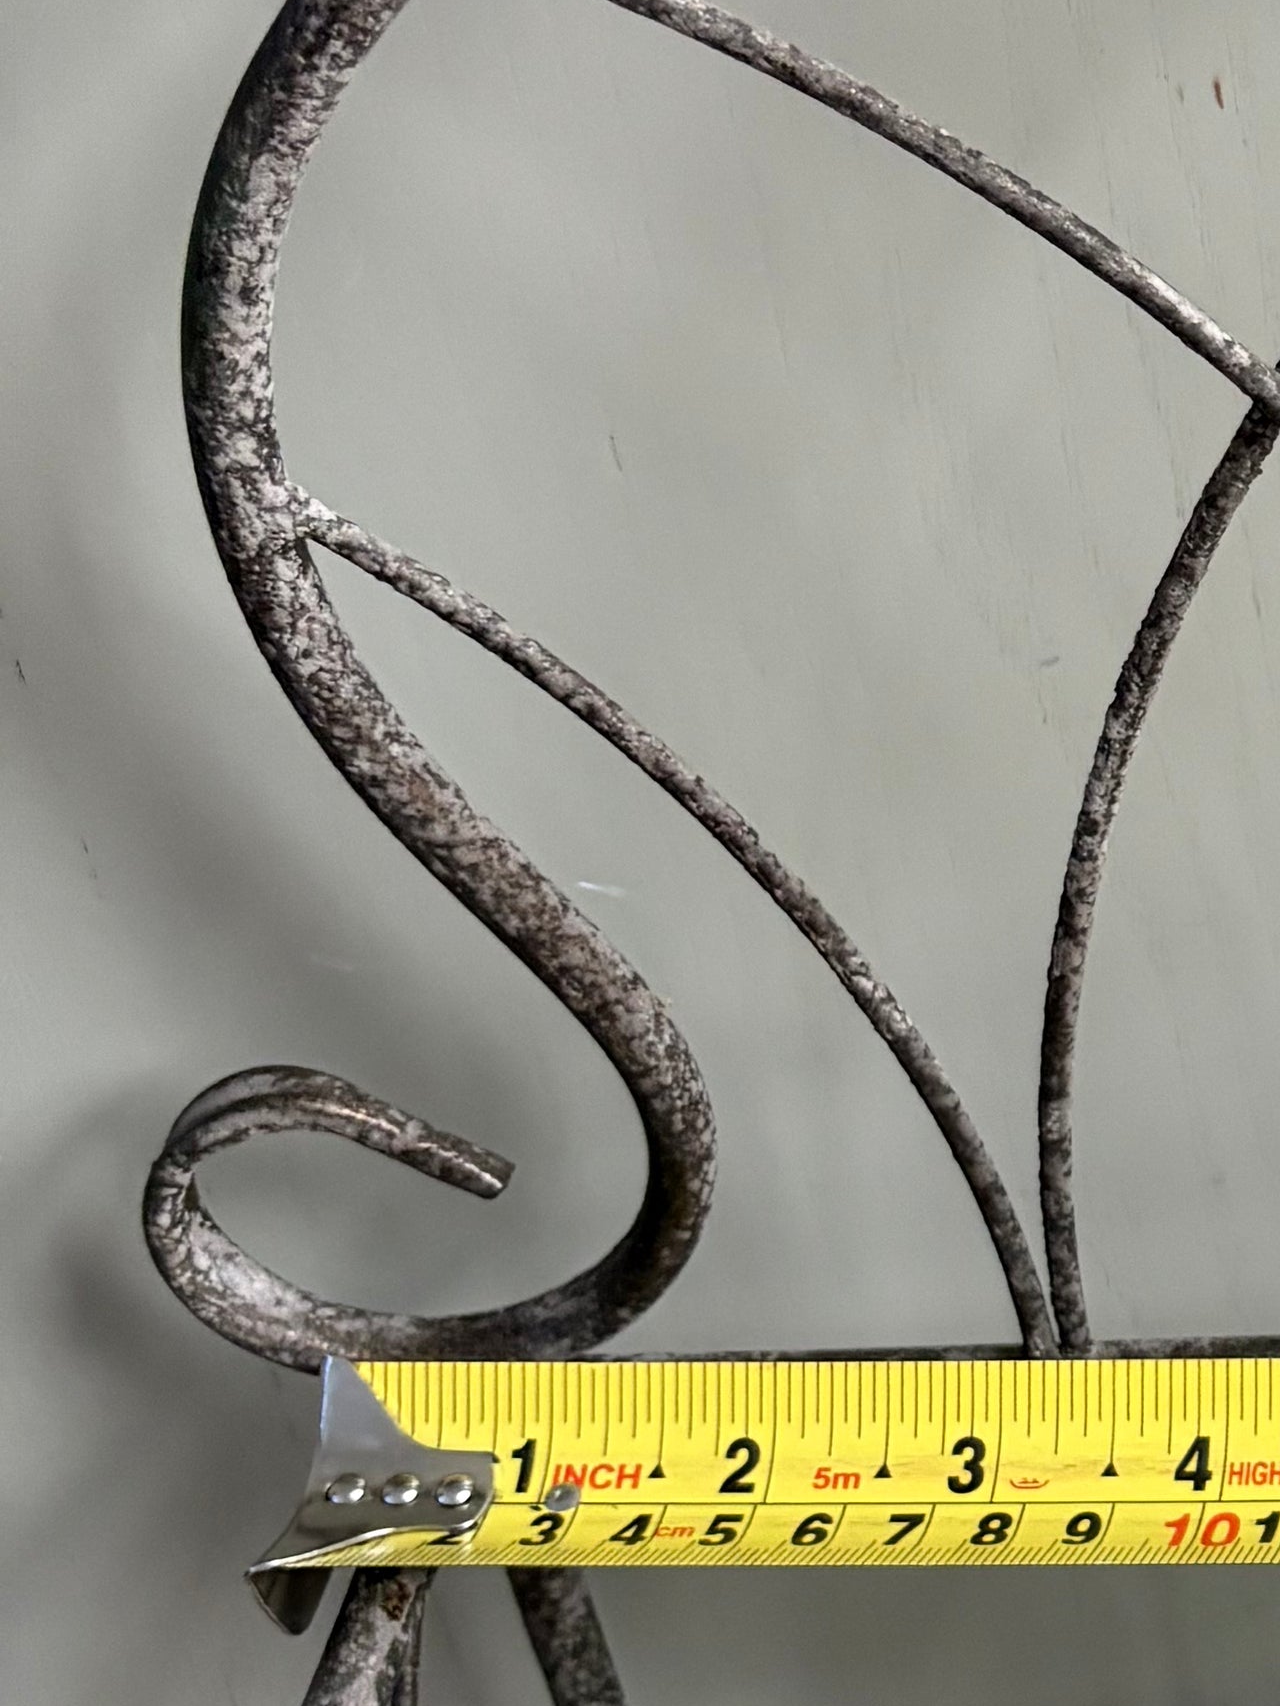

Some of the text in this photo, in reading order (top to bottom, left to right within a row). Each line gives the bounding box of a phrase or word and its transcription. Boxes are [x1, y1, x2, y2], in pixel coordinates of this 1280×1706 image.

[511, 1438, 537, 1493] 1
[552, 1463, 642, 1489] INCH
[719, 1437, 761, 1493] 2
[812, 1467, 861, 1489] 5m
[947, 1436, 986, 1494] 3
[1174, 1436, 1212, 1491] 4
[518, 1514, 565, 1546] 3
[609, 1514, 653, 1545] 4
[654, 1526, 695, 1538] cm
[700, 1514, 744, 1545] 5
[790, 1513, 833, 1546] 6
[882, 1514, 926, 1545] 7
[970, 1513, 1013, 1545] 8
[1061, 1512, 1100, 1545] 9
[1164, 1513, 1241, 1547] 10
